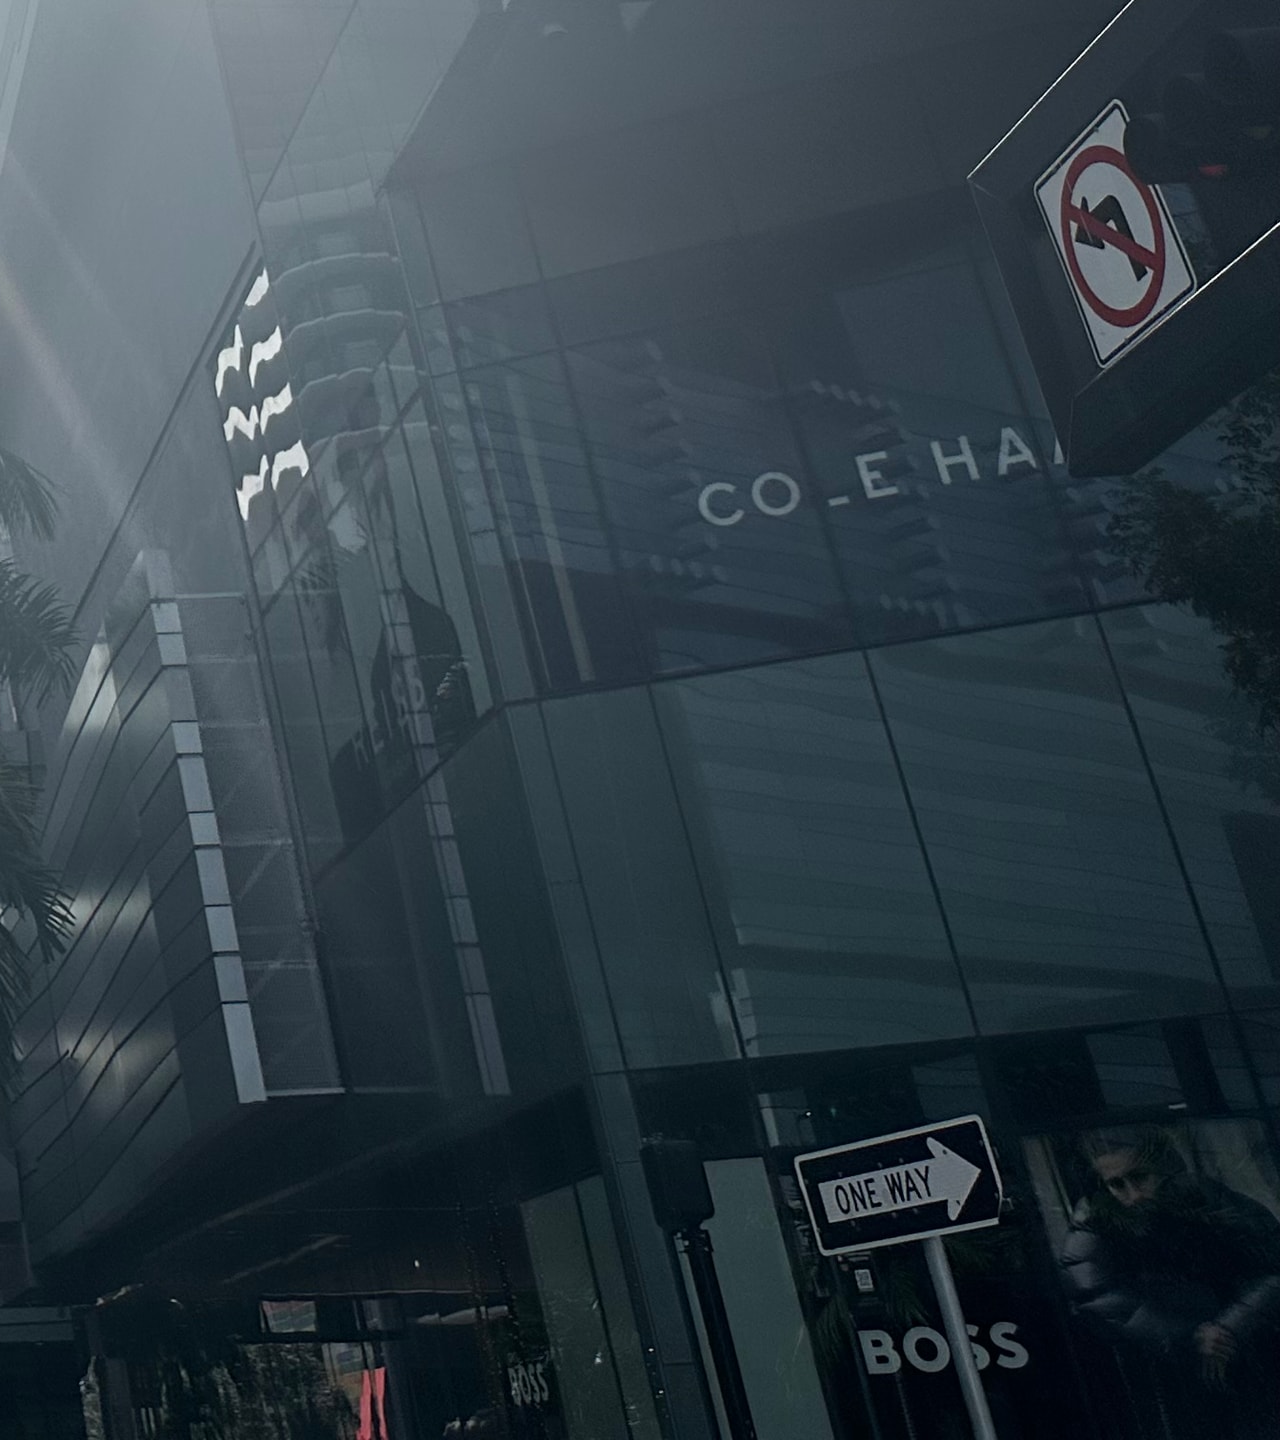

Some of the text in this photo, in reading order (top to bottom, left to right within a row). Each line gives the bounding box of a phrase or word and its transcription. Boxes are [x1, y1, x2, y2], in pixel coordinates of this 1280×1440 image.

[698, 426, 1065, 526] COE HA
[834, 1165, 933, 1215] ONE WAY
[507, 1362, 550, 1407] BOSS
